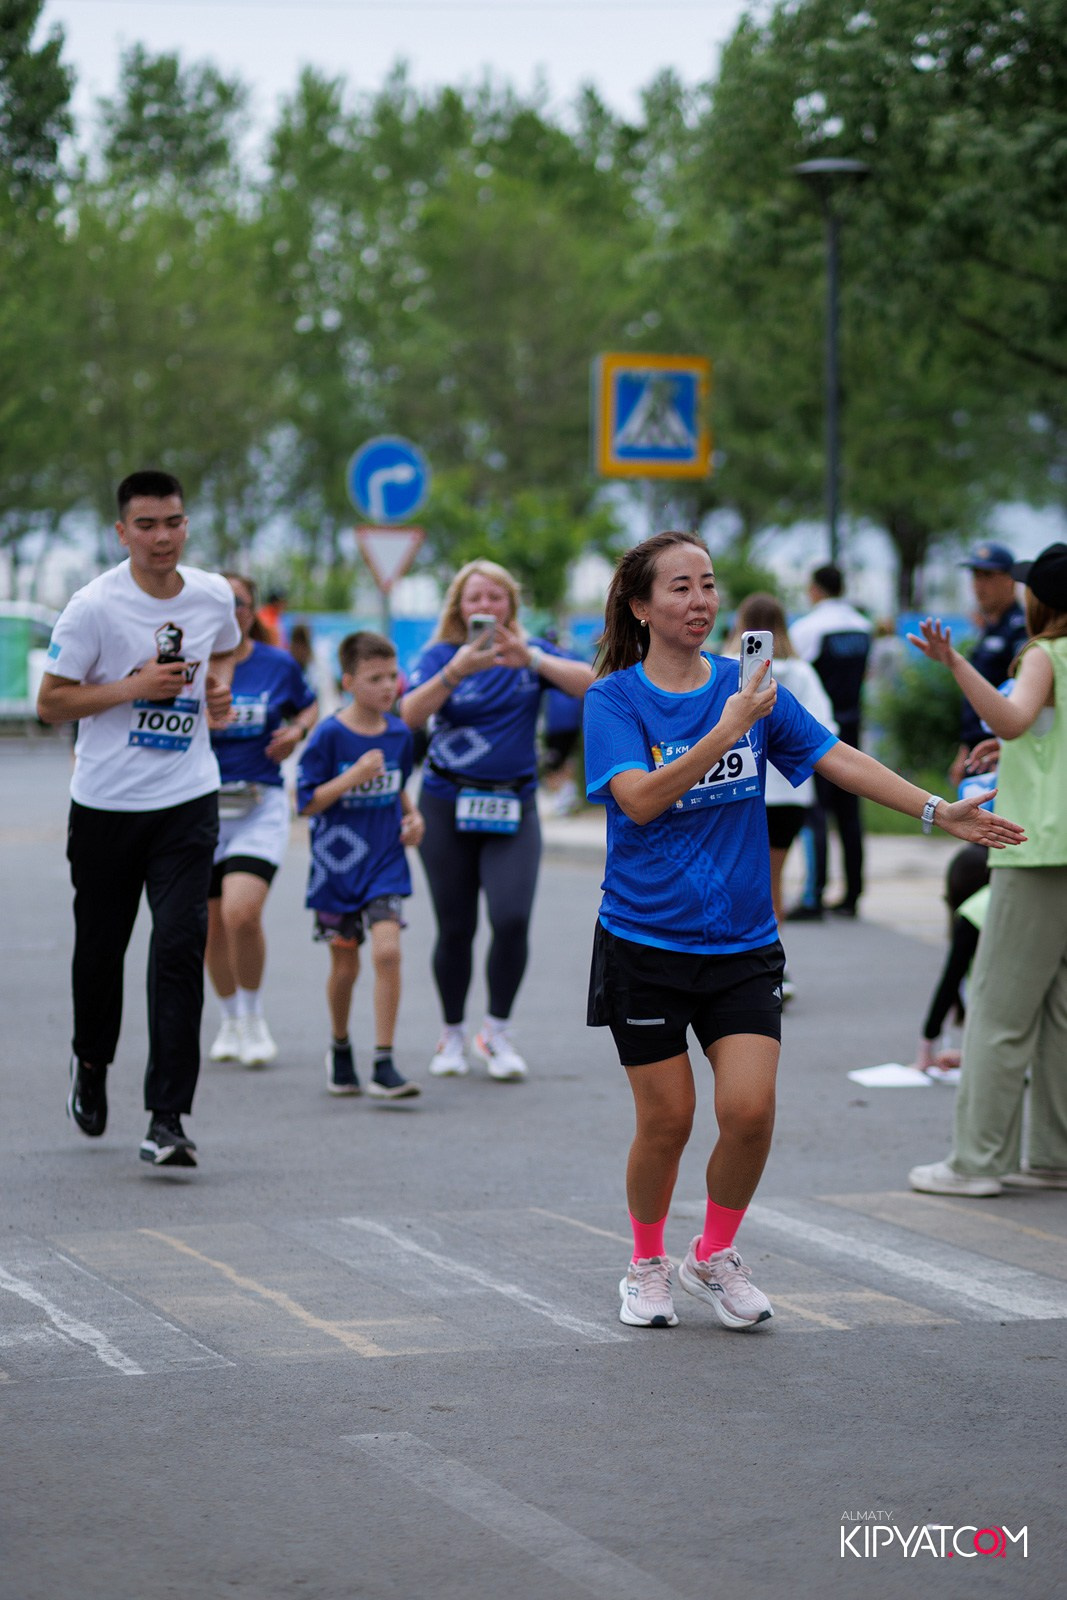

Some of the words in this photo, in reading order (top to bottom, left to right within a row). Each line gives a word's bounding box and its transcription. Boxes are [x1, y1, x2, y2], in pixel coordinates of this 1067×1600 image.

[137, 711, 194, 733] 1000
[666, 746, 673, 756] 5
[675, 745, 689, 754] KM
